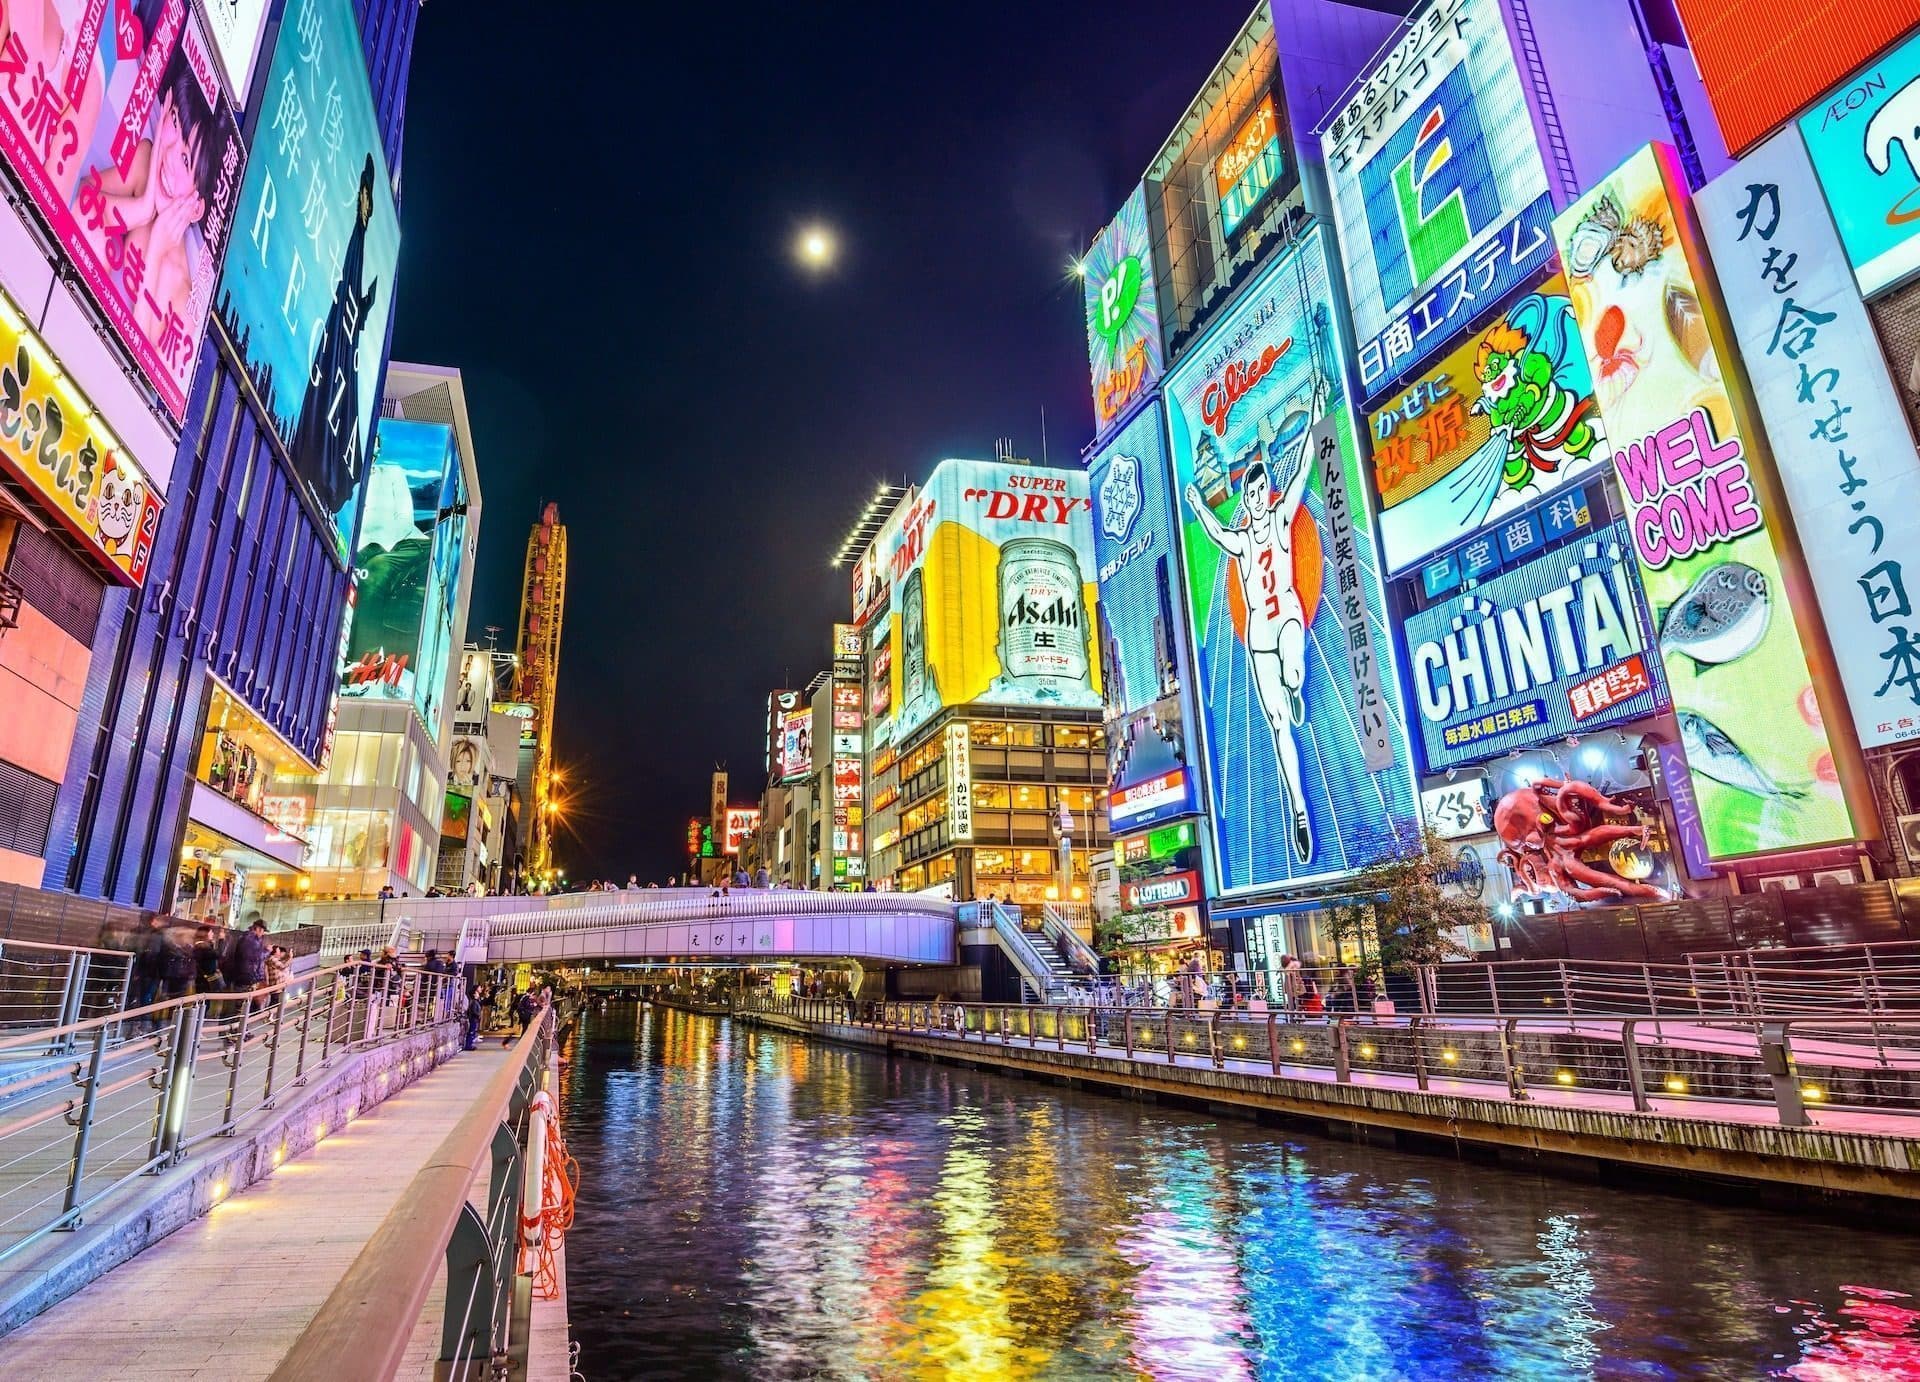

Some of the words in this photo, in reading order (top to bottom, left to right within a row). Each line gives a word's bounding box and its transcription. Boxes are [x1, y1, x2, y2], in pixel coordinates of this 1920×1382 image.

[119, 9, 135, 52] VS
[186, 35, 216, 105] NMB48
[1331, 0, 1455, 145] 夢あるマンショ
[1336, 17, 1468, 173] エステムコート
[78, 164, 194, 377] みるきー派?
[1357, 218, 1549, 385] 日商エステム
[251, 165, 359, 480] REGZA
[1098, 337, 1145, 421] ピップ
[1201, 335, 1294, 437] Glico
[1374, 373, 1451, 440] かぜに
[1372, 394, 1470, 493] 改源
[1615, 410, 1740, 503] WEL
[1736, 183, 1920, 707] 力を合わせよう日本
[1008, 476, 1066, 492] SUPER
[1577, 511, 1589, 524] 3F
[1635, 465, 1758, 565] COME
[132, 504, 155, 572] 2F
[1100, 531, 1153, 583] 雪印メグミルク
[1008, 593, 1078, 629] Asahi
[1257, 544, 1281, 620] グリコ
[1319, 436, 1386, 749] みんなに笑顔を届けたい。
[349, 651, 409, 686] H&M
[1025, 656, 1069, 664] スーパードライ
[1034, 631, 1056, 648] 生
[1414, 557, 1642, 722] CHINTAI
[1444, 705, 1538, 746] 毎週水曜日発売
[1570, 675, 1613, 718] 賃貸
[1877, 717, 1920, 733] 広告
[1648, 748, 1661, 785] 2F
[1436, 791, 1474, 829] くくる
[1139, 880, 1185, 901] LOTTERIA
